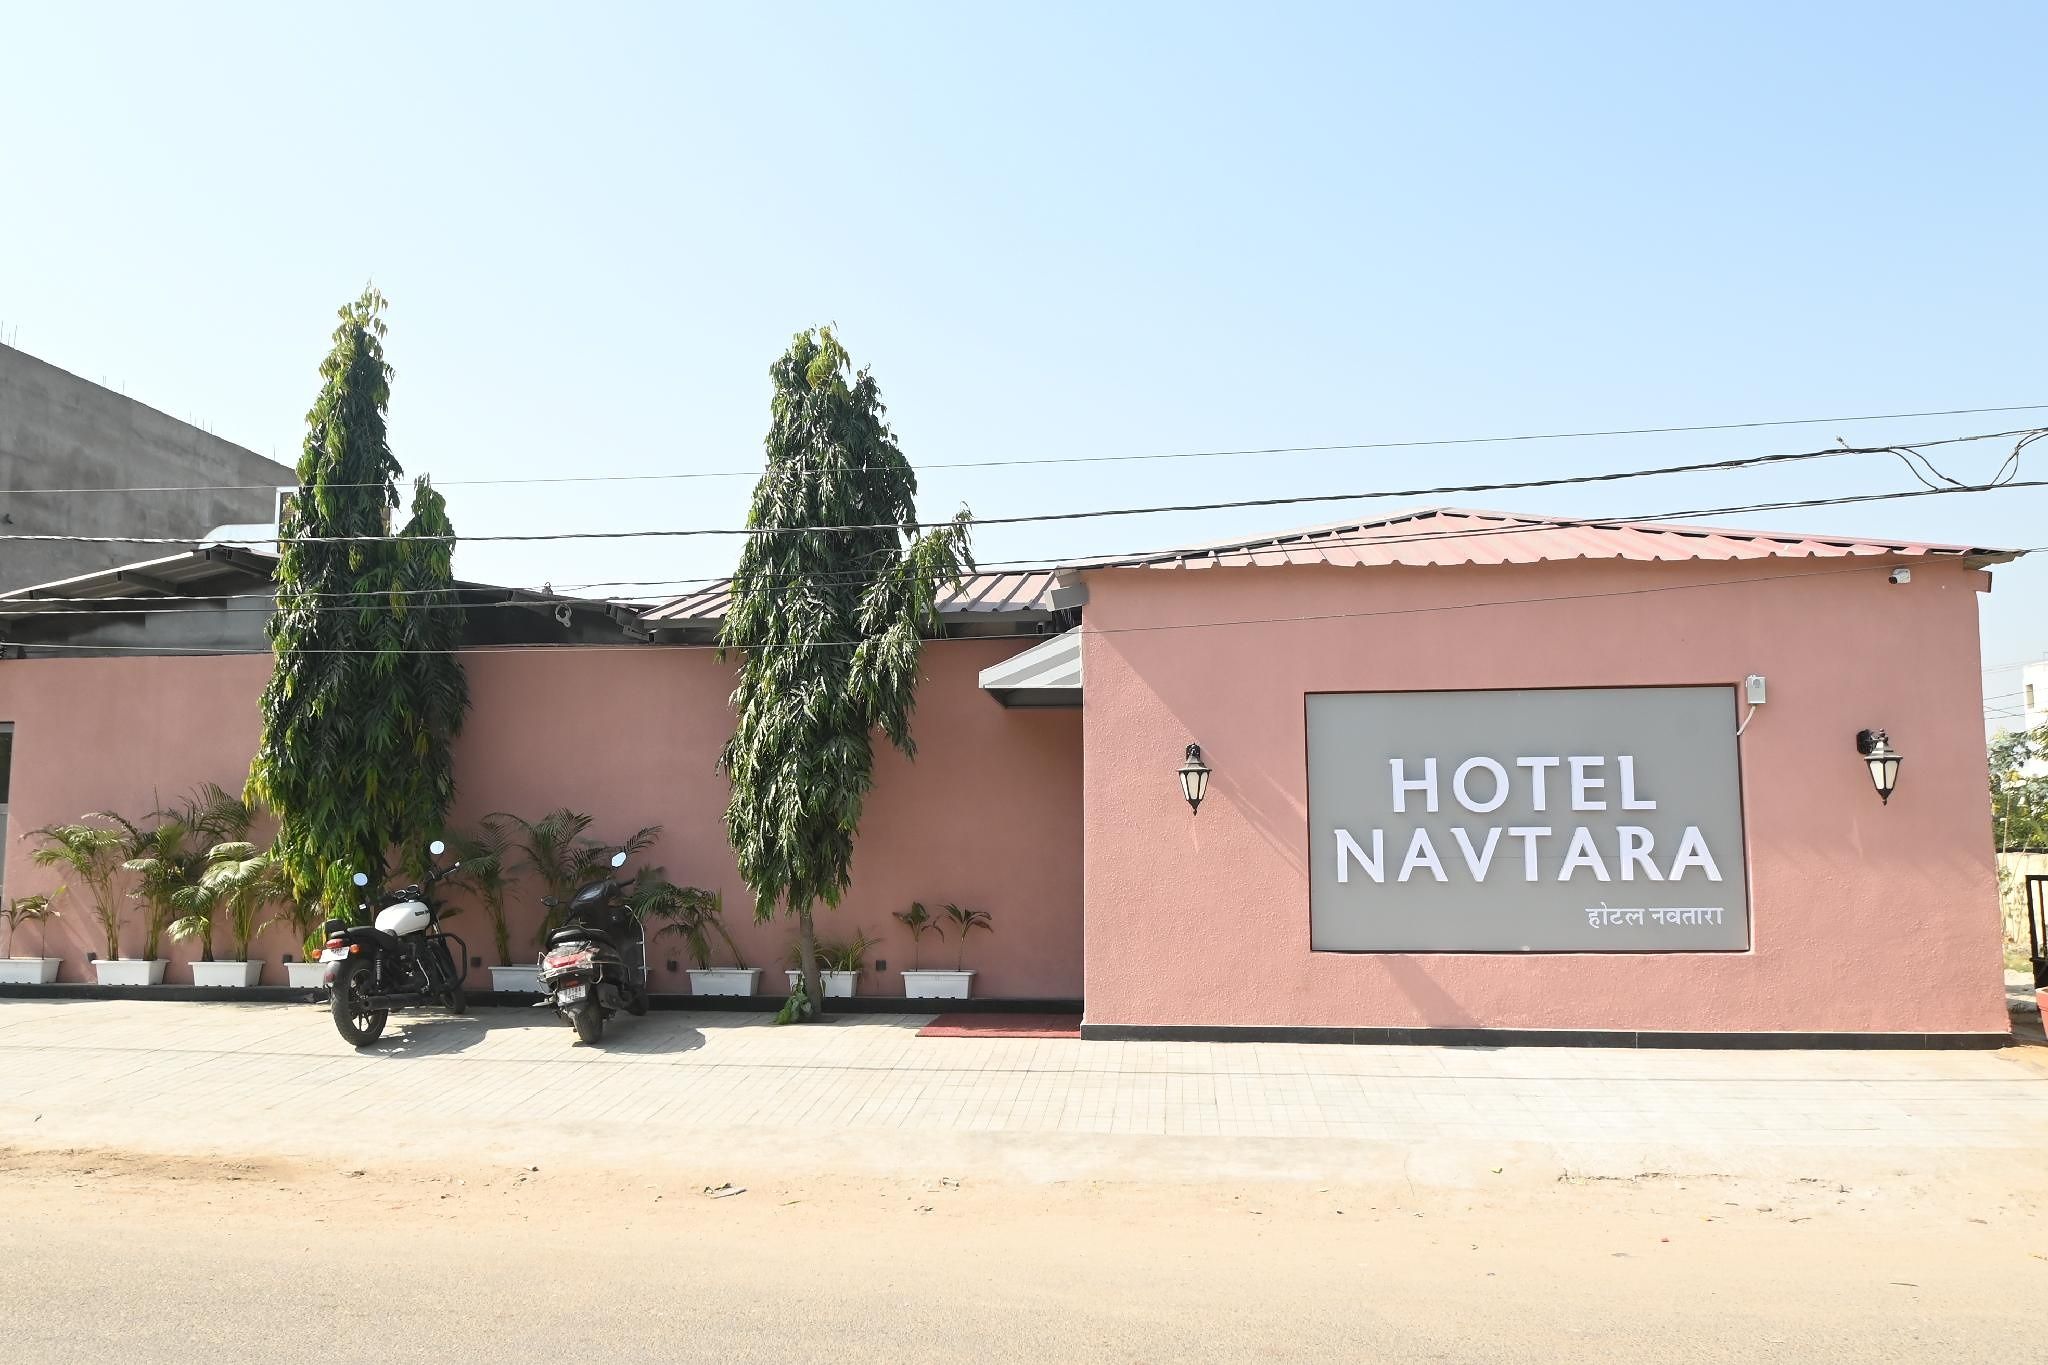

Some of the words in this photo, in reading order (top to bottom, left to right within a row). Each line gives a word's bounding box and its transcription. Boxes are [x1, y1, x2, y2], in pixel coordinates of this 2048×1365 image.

[1389, 755, 1657, 813] HOTEL
[1334, 826, 1723, 883] NAVTARA
[1585, 902, 1645, 928] होटल
[1649, 907, 1724, 925] नवतारा
